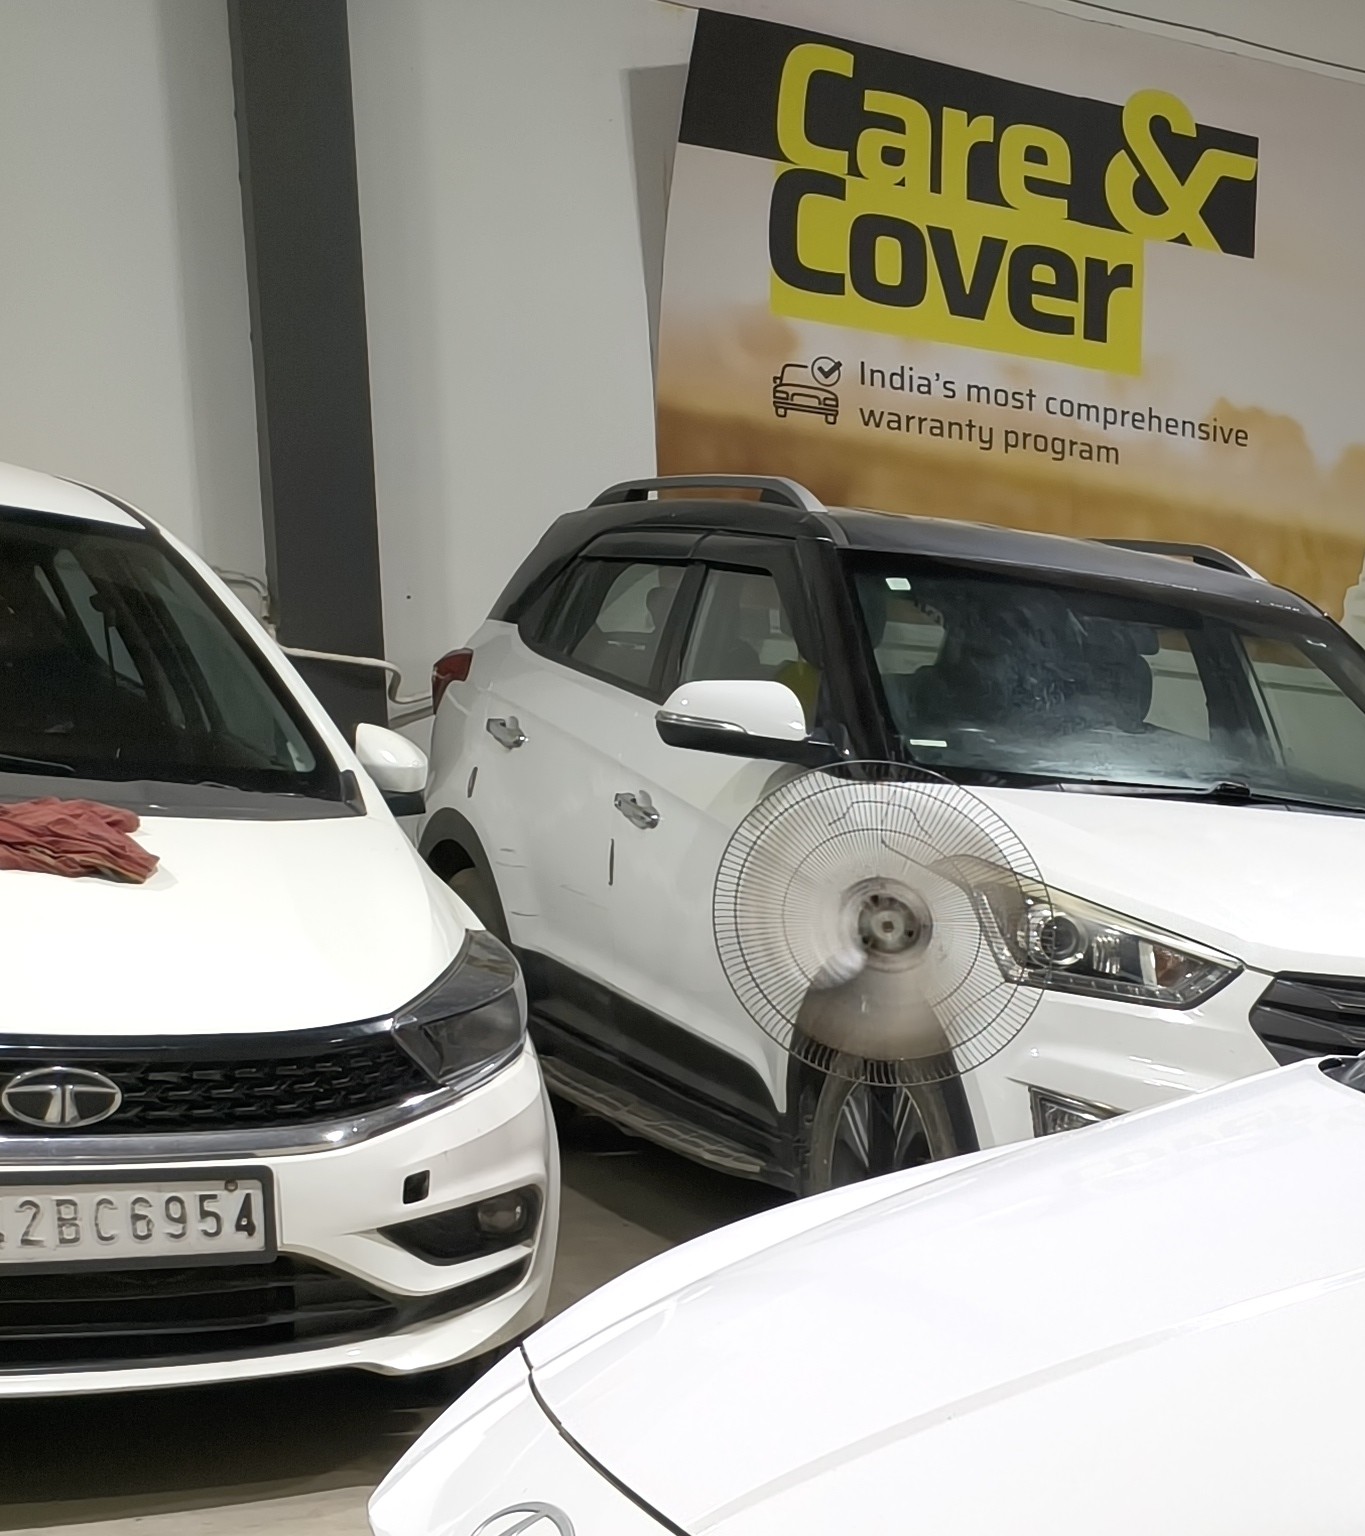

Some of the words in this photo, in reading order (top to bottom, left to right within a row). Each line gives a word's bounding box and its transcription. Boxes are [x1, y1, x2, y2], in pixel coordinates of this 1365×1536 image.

[777, 43, 1071, 219] Care
[1105, 88, 1258, 255] &
[769, 167, 1133, 343] Cover
[859, 407, 993, 451] warranty
[1004, 428, 1120, 465] program
[860, 361, 956, 399] India's
[967, 383, 1037, 411] most
[1045, 396, 1249, 447] comprehensive
[0, 1192, 256, 1246] 2BC6954
